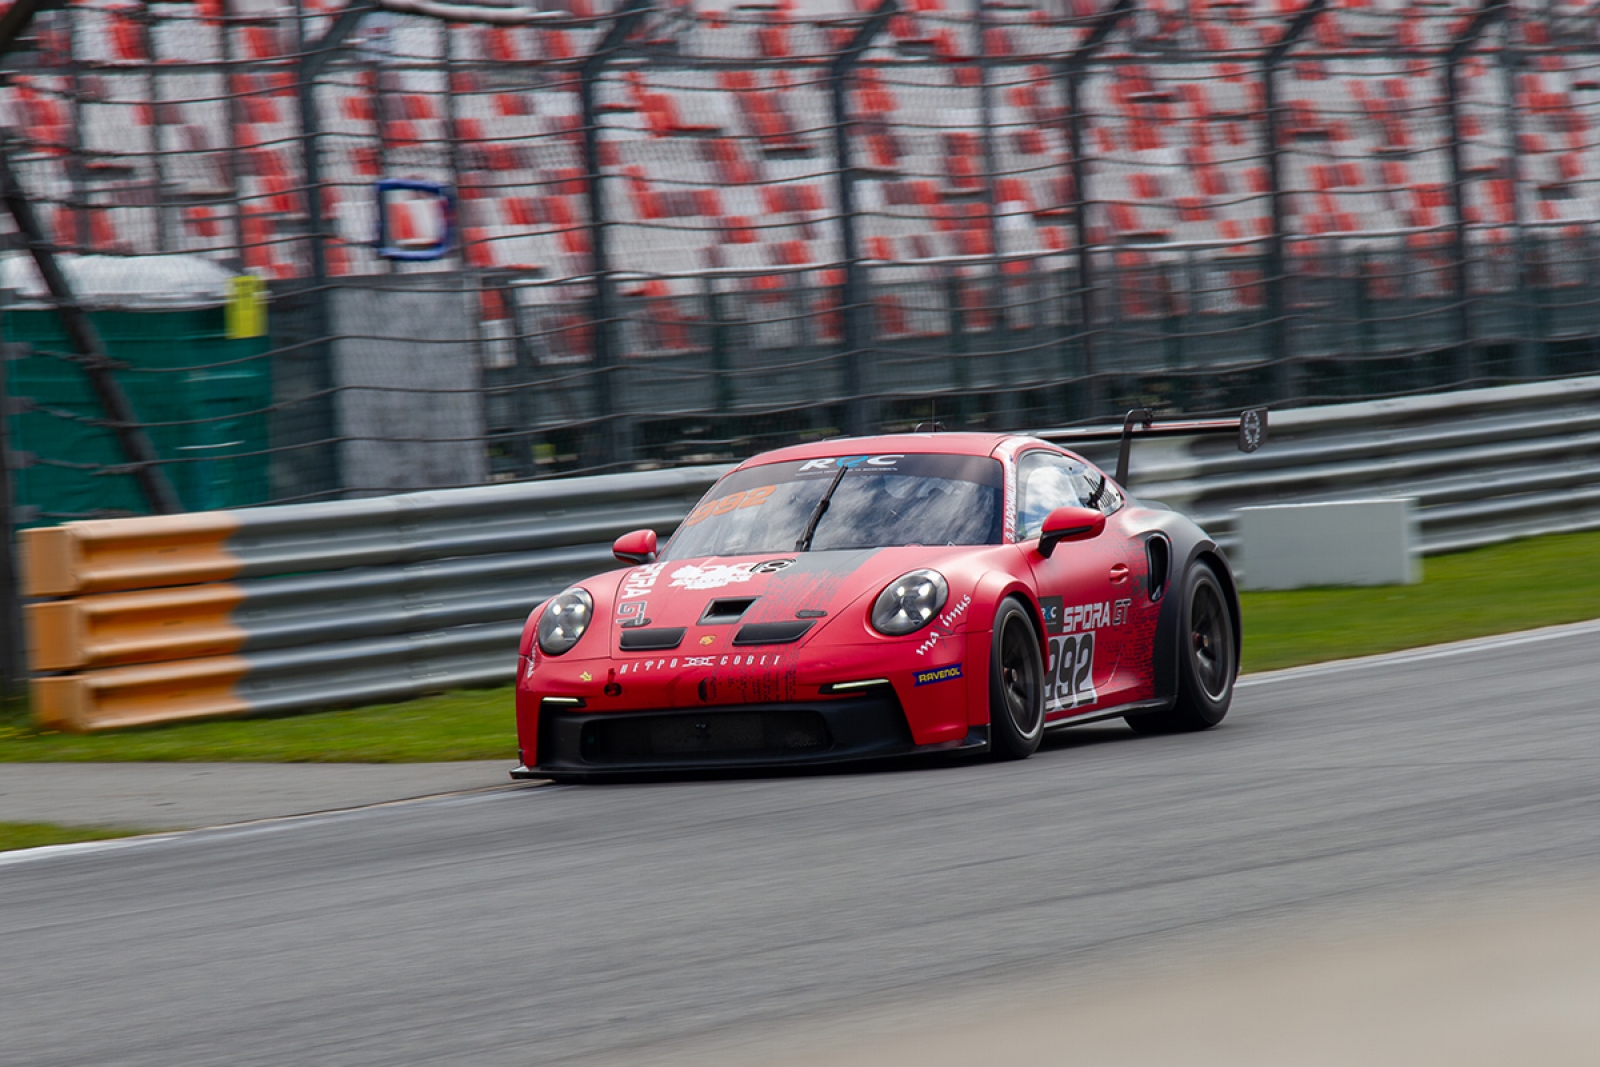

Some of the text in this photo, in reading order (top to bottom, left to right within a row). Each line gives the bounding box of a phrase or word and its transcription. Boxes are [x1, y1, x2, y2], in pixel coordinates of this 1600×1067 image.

[686, 484, 777, 527] 992
[616, 601, 651, 627] GT
[1063, 598, 1132, 632] SPORA GT
[719, 655, 781, 666] СОВЕТ
[918, 667, 961, 683] RAVENOL
[1044, 633, 1095, 710] 992
